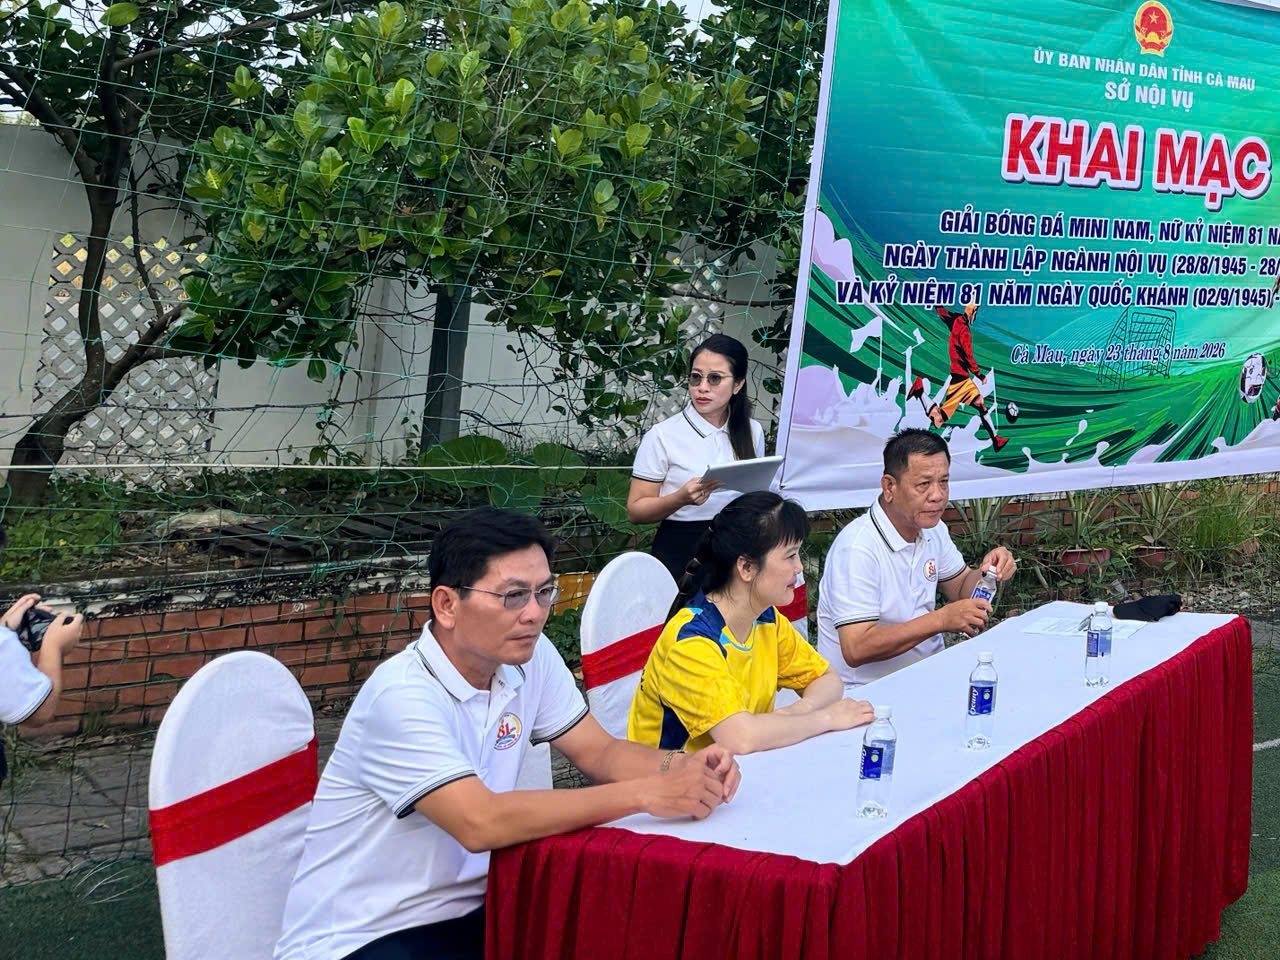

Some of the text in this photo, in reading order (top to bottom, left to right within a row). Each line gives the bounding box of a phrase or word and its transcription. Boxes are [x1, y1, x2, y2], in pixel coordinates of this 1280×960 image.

[1033, 47, 1256, 91] ỦY BAN NHÂN DÂN TỈNH CÀ MAU
[1104, 77, 1194, 113] SỞ NỘI VỤ
[1003, 115, 1270, 207] KHAI MẠC
[940, 204, 981, 235] GIẢI
[985, 209, 1036, 237] BÓNG
[1041, 213, 1065, 238] ĐÁ
[1069, 217, 1109, 239] MINI
[1113, 218, 1155, 243] NAM,
[1159, 219, 1183, 242] NỮ
[1185, 218, 1204, 243] KỶ
[1208, 222, 1244, 248] NIỆM
[1248, 226, 1263, 245] 81
[884, 241, 940, 269] NGÀY
[945, 243, 1008, 271] THÀNH
[1012, 245, 1047, 275] LẬP
[1051, 247, 1110, 274] NGÀNH
[1114, 250, 1144, 278] NỘI
[1148, 253, 1167, 279] VỤ
[1171, 254, 1247, 276] (28/8/1945
[836, 278, 863, 305] VÀ
[869, 275, 898, 305] KỶ
[902, 278, 955, 309] NIỆM
[960, 282, 982, 306] 81
[988, 278, 1033, 306] NĂM
[1036, 281, 1085, 307] NGÀY
[1088, 279, 1132, 307] QUỐC
[1136, 282, 1188, 307] KHÁNH
[1192, 287, 1273, 308] (02/9/1945)
[1011, 342, 1225, 366] Cà Mau, ngày 23 tháng 8 năm 2026
